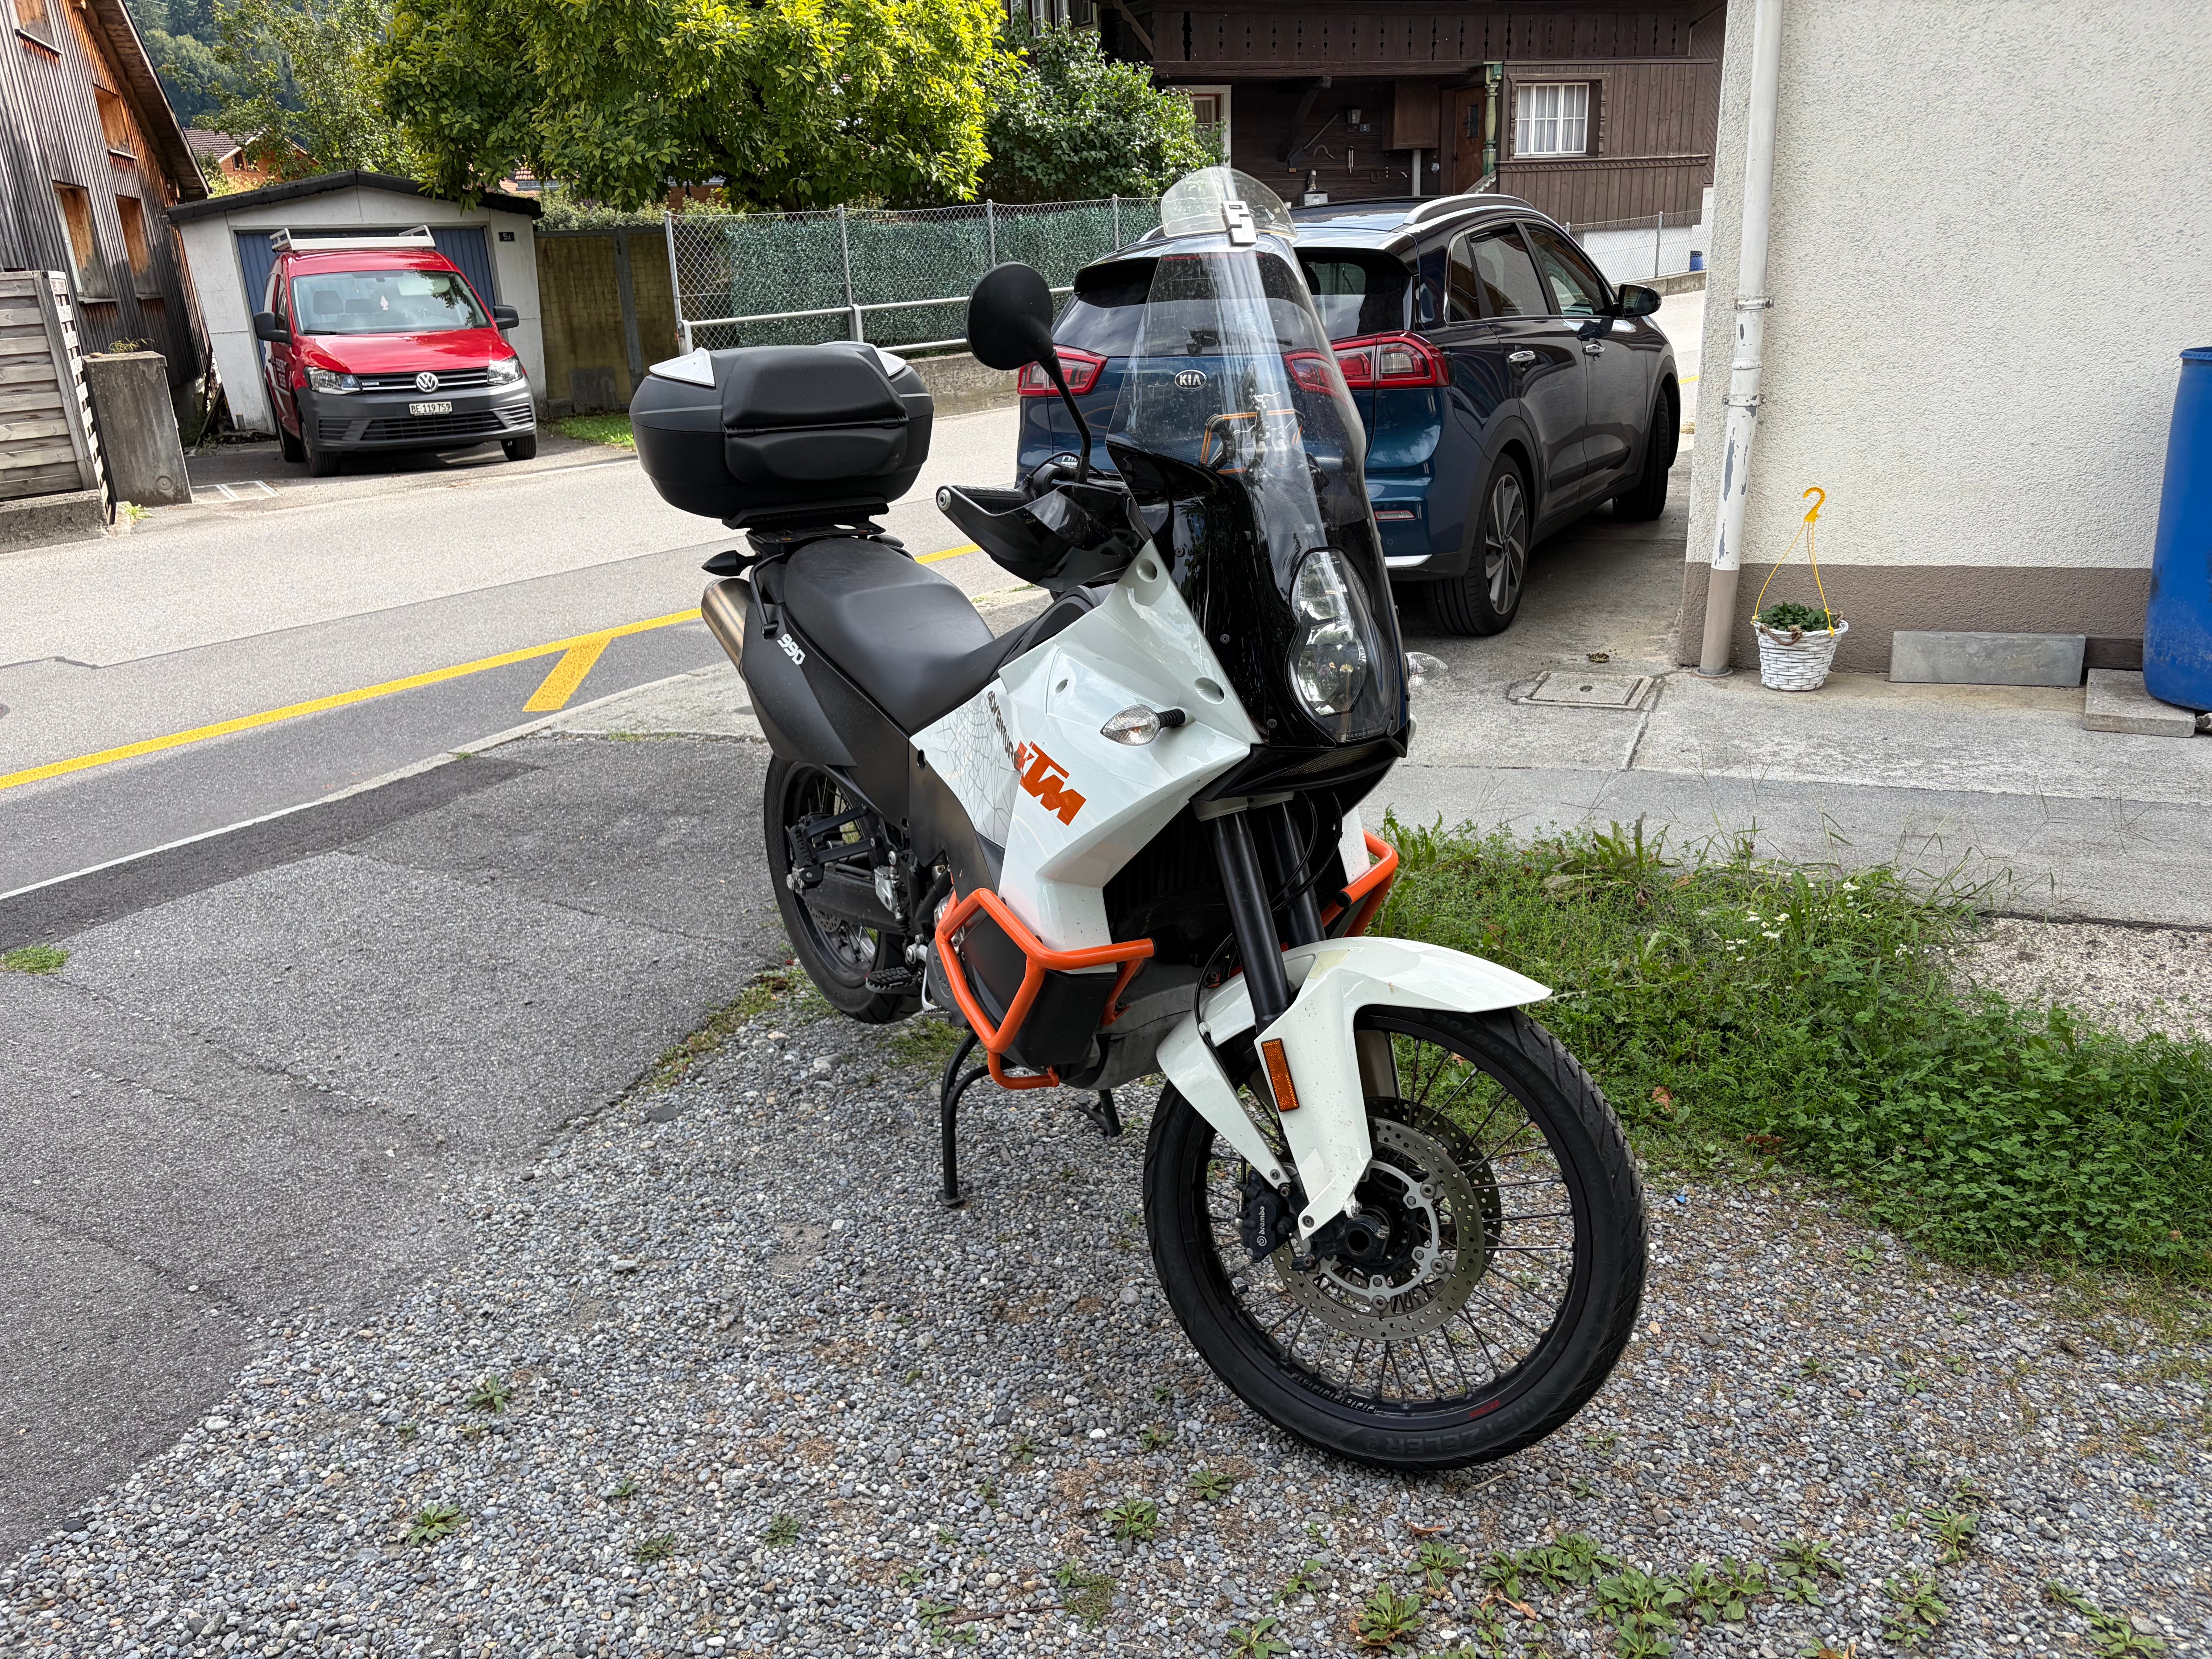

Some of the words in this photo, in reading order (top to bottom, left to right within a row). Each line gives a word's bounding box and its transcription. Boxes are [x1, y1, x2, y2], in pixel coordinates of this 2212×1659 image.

[1180, 374, 1201, 385] KIA
[777, 634, 805, 665] 990
[987, 690, 1022, 771] ADVENTURE
[1016, 740, 1087, 826] KTM
[1385, 1396, 1539, 1454] METZELER
